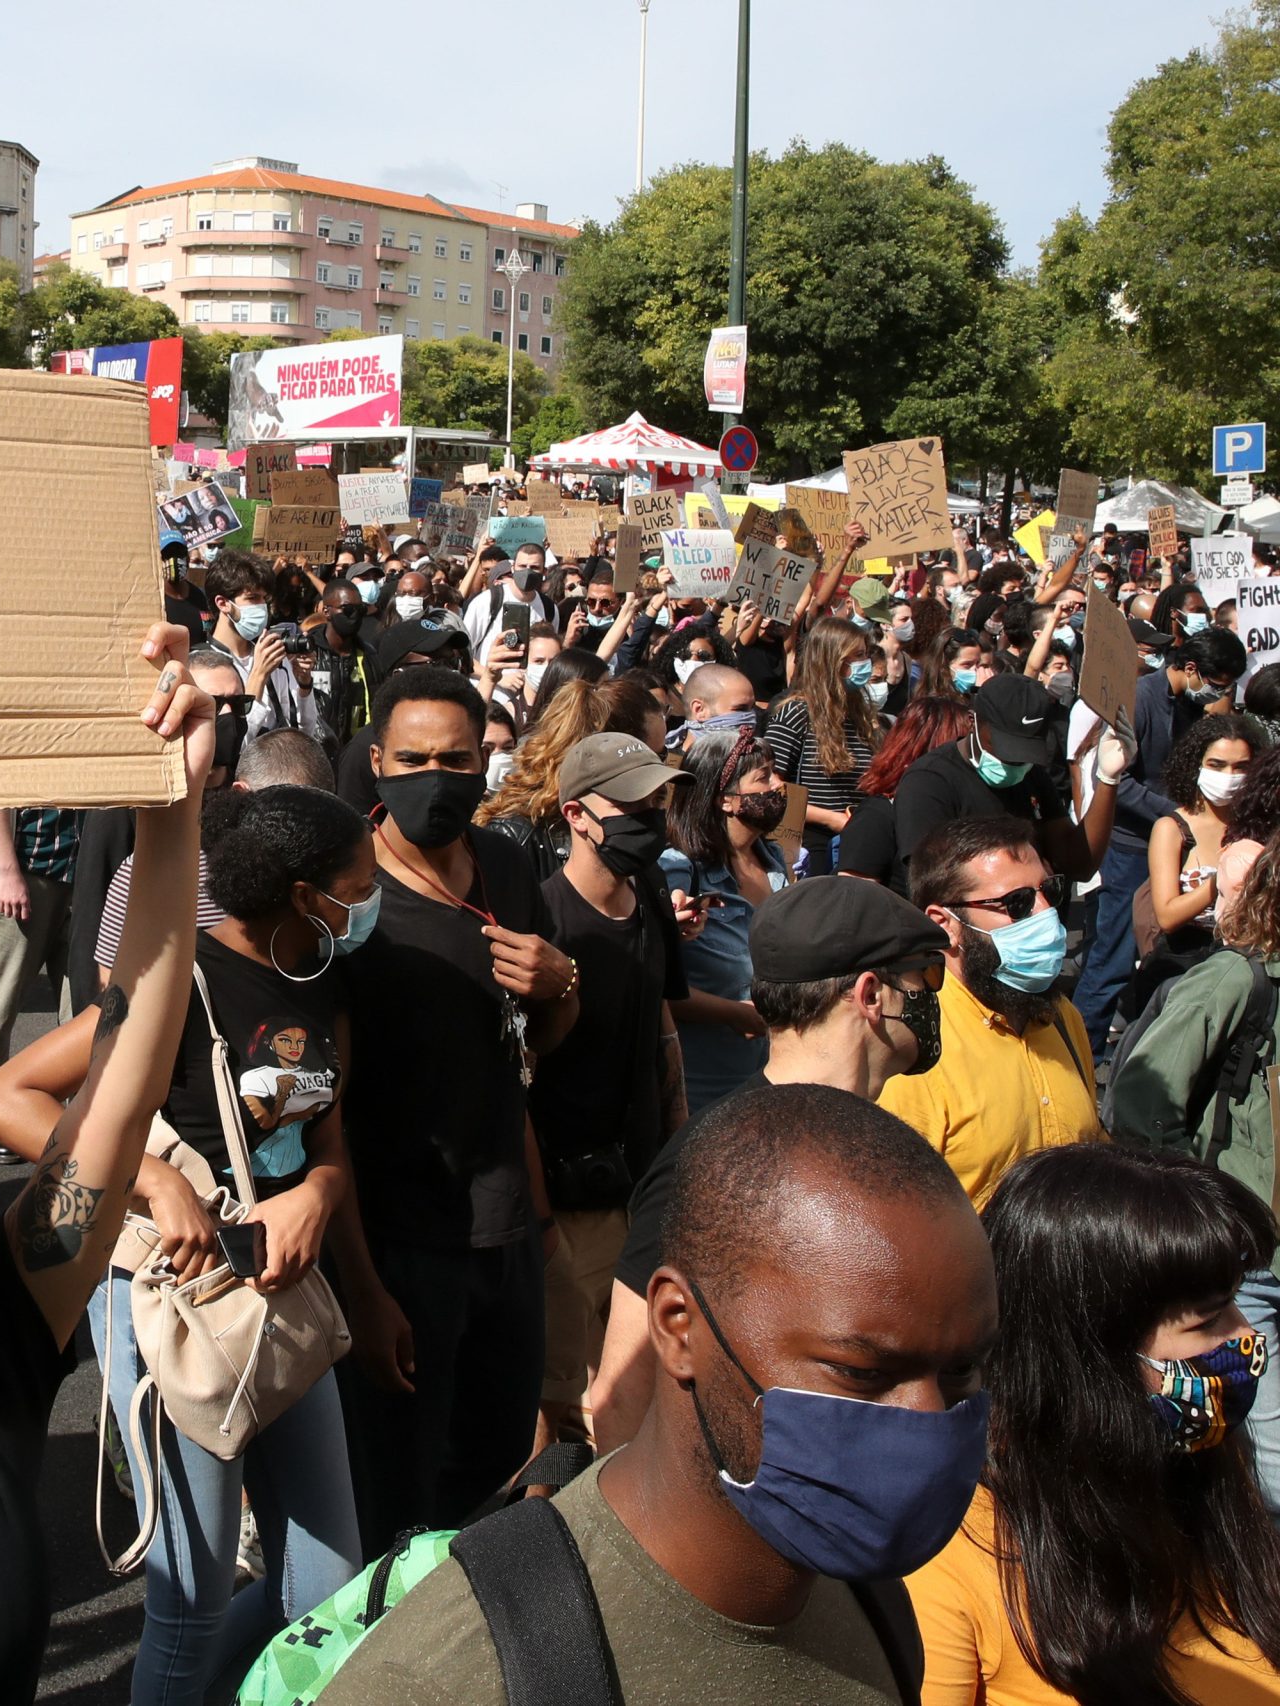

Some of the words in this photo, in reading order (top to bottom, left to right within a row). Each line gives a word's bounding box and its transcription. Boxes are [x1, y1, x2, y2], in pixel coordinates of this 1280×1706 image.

[277, 356, 339, 383] NINGUÉM
[156, 385, 174, 398] PCP
[280, 381, 317, 400] FICAR
[320, 377, 356, 398] PARA
[359, 369, 396, 394] TRÁS
[1225, 431, 1253, 467] P
[854, 447, 932, 488] BLACK
[385, 485, 396, 494] TO
[788, 487, 811, 508] SER
[863, 469, 935, 513] LIVES
[634, 496, 674, 516] BLACK
[269, 509, 288, 524] WE
[290, 510, 310, 524] ARE
[312, 510, 338, 526] NOT
[643, 512, 674, 530] LIVES
[869, 496, 942, 542] MATTER
[665, 531, 689, 547] WE
[672, 548, 712, 565] BLEED
[714, 547, 733, 563] THE
[1197, 552, 1203, 567] I
[1205, 551, 1223, 567] MET
[1227, 550, 1245, 568] GOD
[701, 567, 731, 583] COLOR
[772, 556, 805, 581] ARE
[1197, 567, 1213, 579] AND
[1244, 565, 1251, 578] A
[1247, 626, 1280, 653] END
[287, 1074, 333, 1098] AVAGE
